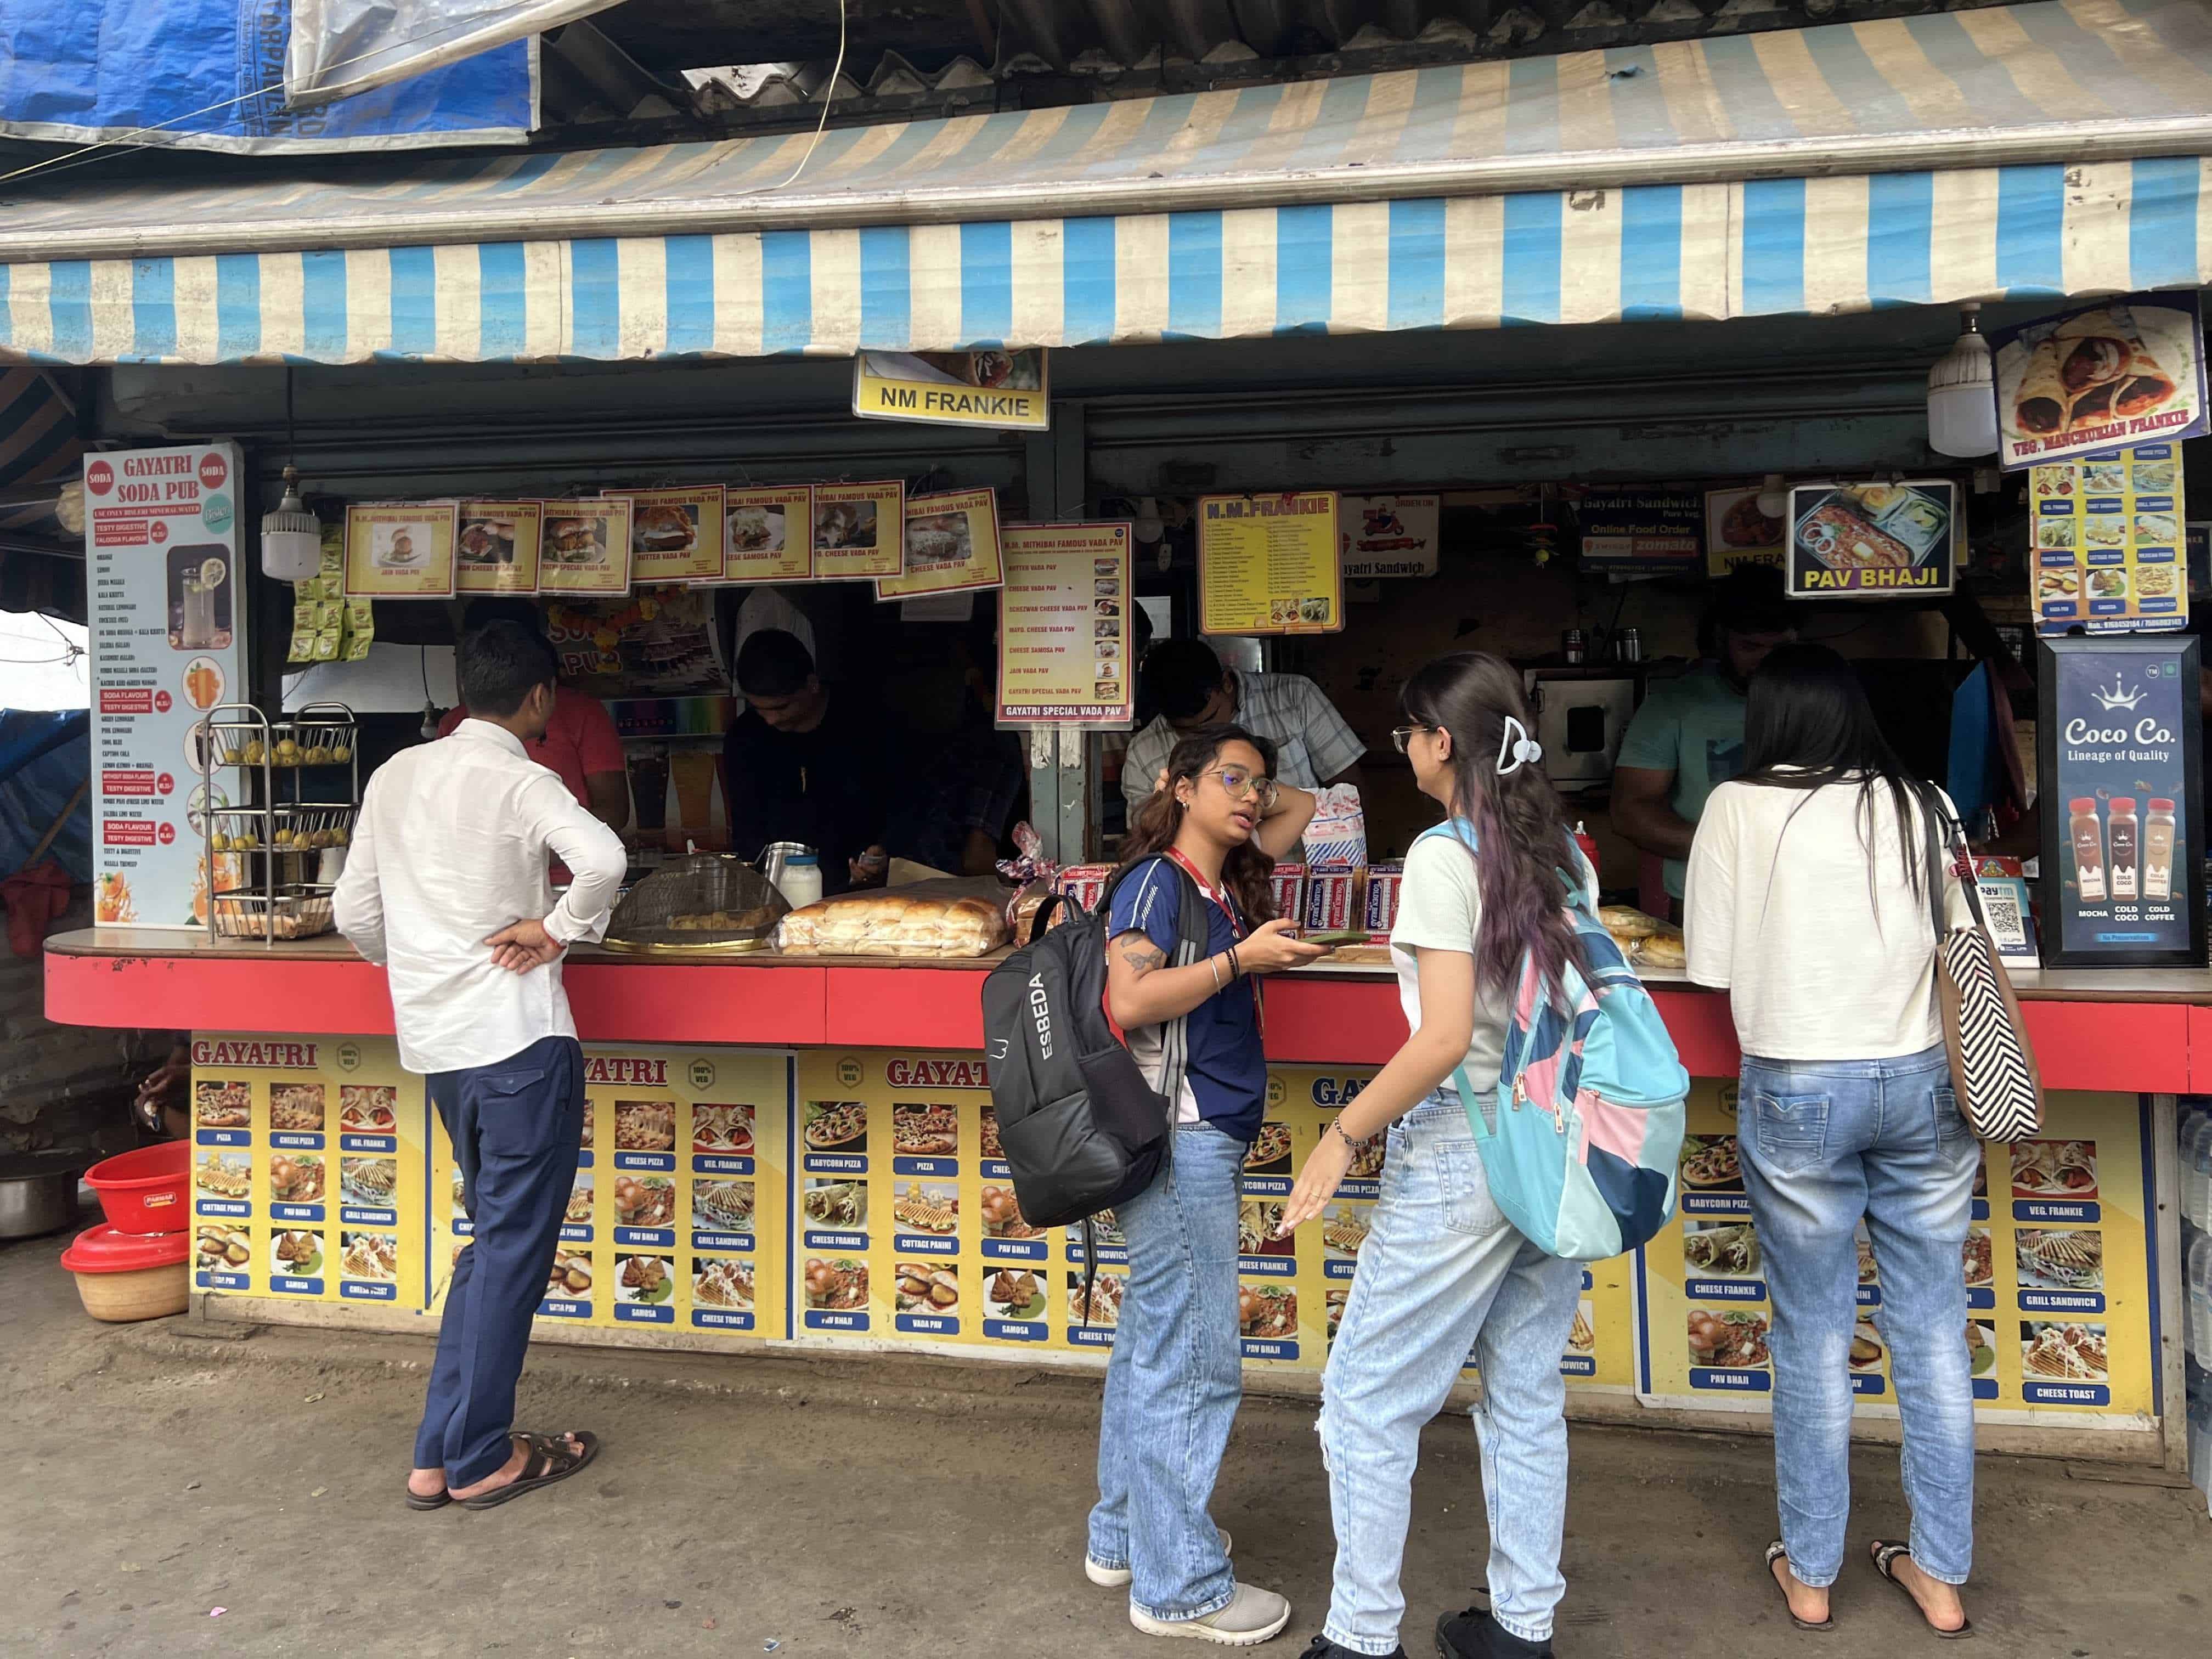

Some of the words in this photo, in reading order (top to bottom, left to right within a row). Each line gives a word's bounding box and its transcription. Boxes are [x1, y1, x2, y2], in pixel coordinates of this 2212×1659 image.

[881, 387, 917, 408] NM
[926, 391, 1029, 416] FRANKIE
[2013, 440, 2040, 456] VEG.
[2043, 421, 2126, 450] MANCHURIAN
[2130, 409, 2189, 432] FRANKIE
[124, 455, 192, 476] GAYATRI
[201, 466, 224, 477] SODA
[89, 473, 112, 483] SODA
[118, 483, 160, 503] SODA
[166, 481, 199, 500] PUB
[838, 493, 865, 501] FAMOUS
[746, 496, 772, 505] FAMOUS
[927, 503, 953, 514] FAMOUS
[956, 501, 974, 510] VADA
[975, 499, 988, 507] PAV
[1592, 523, 1624, 535] Online
[1628, 523, 1655, 535] Food
[1659, 523, 1690, 535] Order
[1023, 540, 1056, 549] MITHIBAI
[1058, 539, 1087, 548] FAMOUS
[1089, 539, 1108, 547] VADA
[1109, 538, 1124, 546] PAV
[1637, 540, 1695, 551] zomato
[825, 549, 849, 557] CHEESE
[911, 565, 934, 573] CHEESE
[1375, 562, 1424, 574] Sandwich
[1804, 569, 1852, 589] PAV
[1860, 567, 1938, 586] BHAJI
[1006, 707, 1041, 715] GAYATRI
[1043, 707, 1078, 715] SPECIAL
[1080, 707, 1102, 715] VADA
[1105, 706, 1121, 715] PAV
[2065, 718, 2128, 745] Coco
[2135, 718, 2176, 745] Co.
[2068, 750, 2112, 763] Lineage
[2115, 750, 2126, 761] of
[2129, 750, 2169, 763] Quality
[1311, 907, 1319, 926] BREAD
[1029, 972, 1053, 1060] ESBEDA
[191, 1041, 319, 1068] GAYATRI
[693, 1065, 711, 1075] 100%
[696, 1075, 708, 1083] VEG
[844, 1073, 857, 1081] VEG
[279, 1136, 299, 1145] CHEESE
[300, 1137, 314, 1146] PIZZA
[364, 1139, 386, 1148] FRANKIE
[625, 1156, 646, 1165] CHEESE
[646, 1158, 664, 1166] PIZZA
[704, 1160, 718, 1169] VEG.
[719, 1161, 743, 1169] FRANKIE
[810, 1159, 842, 1167] BABYCORN
[843, 1160, 861, 1168] PIZZA
[916, 1163, 934, 1171] PIZZA
[1268, 1182, 1286, 1191] PIZZA
[1361, 1185, 1379, 1194] PIZZA
[1690, 1198, 1731, 1209] BABYCORN
[361, 1211, 391, 1221] SANDWICH
[2029, 1206, 2047, 1216] VEG.
[2049, 1206, 2083, 1217] FRANKIE
[567, 1228, 586, 1237] PANINI
[629, 1232, 641, 1240] PAV
[642, 1233, 659, 1242] BHAJI
[697, 1235, 713, 1245] GRILL
[714, 1237, 749, 1247] SANDWICH
[811, 1235, 835, 1244] CHEESE
[836, 1237, 861, 1245] FRANKIE
[901, 1239, 929, 1248] COTTAGE
[930, 1241, 951, 1250] PANINI
[998, 1245, 1011, 1254] PAV
[1012, 1245, 1030, 1255] BHAJI
[1260, 1262, 1288, 1272] FRANKIE
[285, 1280, 308, 1290] SAMOSA
[1695, 1284, 1723, 1295] CHEESE
[1724, 1285, 1756, 1296] FRANKIE
[2027, 1295, 2049, 1307] GRILL
[2050, 1295, 2096, 1308] SANDWICH
[565, 1304, 577, 1312] PAV
[631, 1308, 657, 1318] SAMOSA
[702, 1314, 723, 1324] CHEESE
[725, 1316, 744, 1325] TOAST
[836, 1317, 853, 1326] BHAJI
[912, 1319, 929, 1328] VADA
[930, 1320, 942, 1329] PAV
[1002, 1325, 1029, 1335] SAMOSA
[1078, 1331, 1103, 1341] CHEESE
[1246, 1345, 1260, 1353] PAV
[1261, 1345, 1280, 1355] BHAJI
[1711, 1374, 1725, 1384] PAV
[1727, 1375, 1749, 1385] BHAJI
[2036, 1388, 2067, 1400] CHEESE
[2068, 1389, 2095, 1400] TOAST
